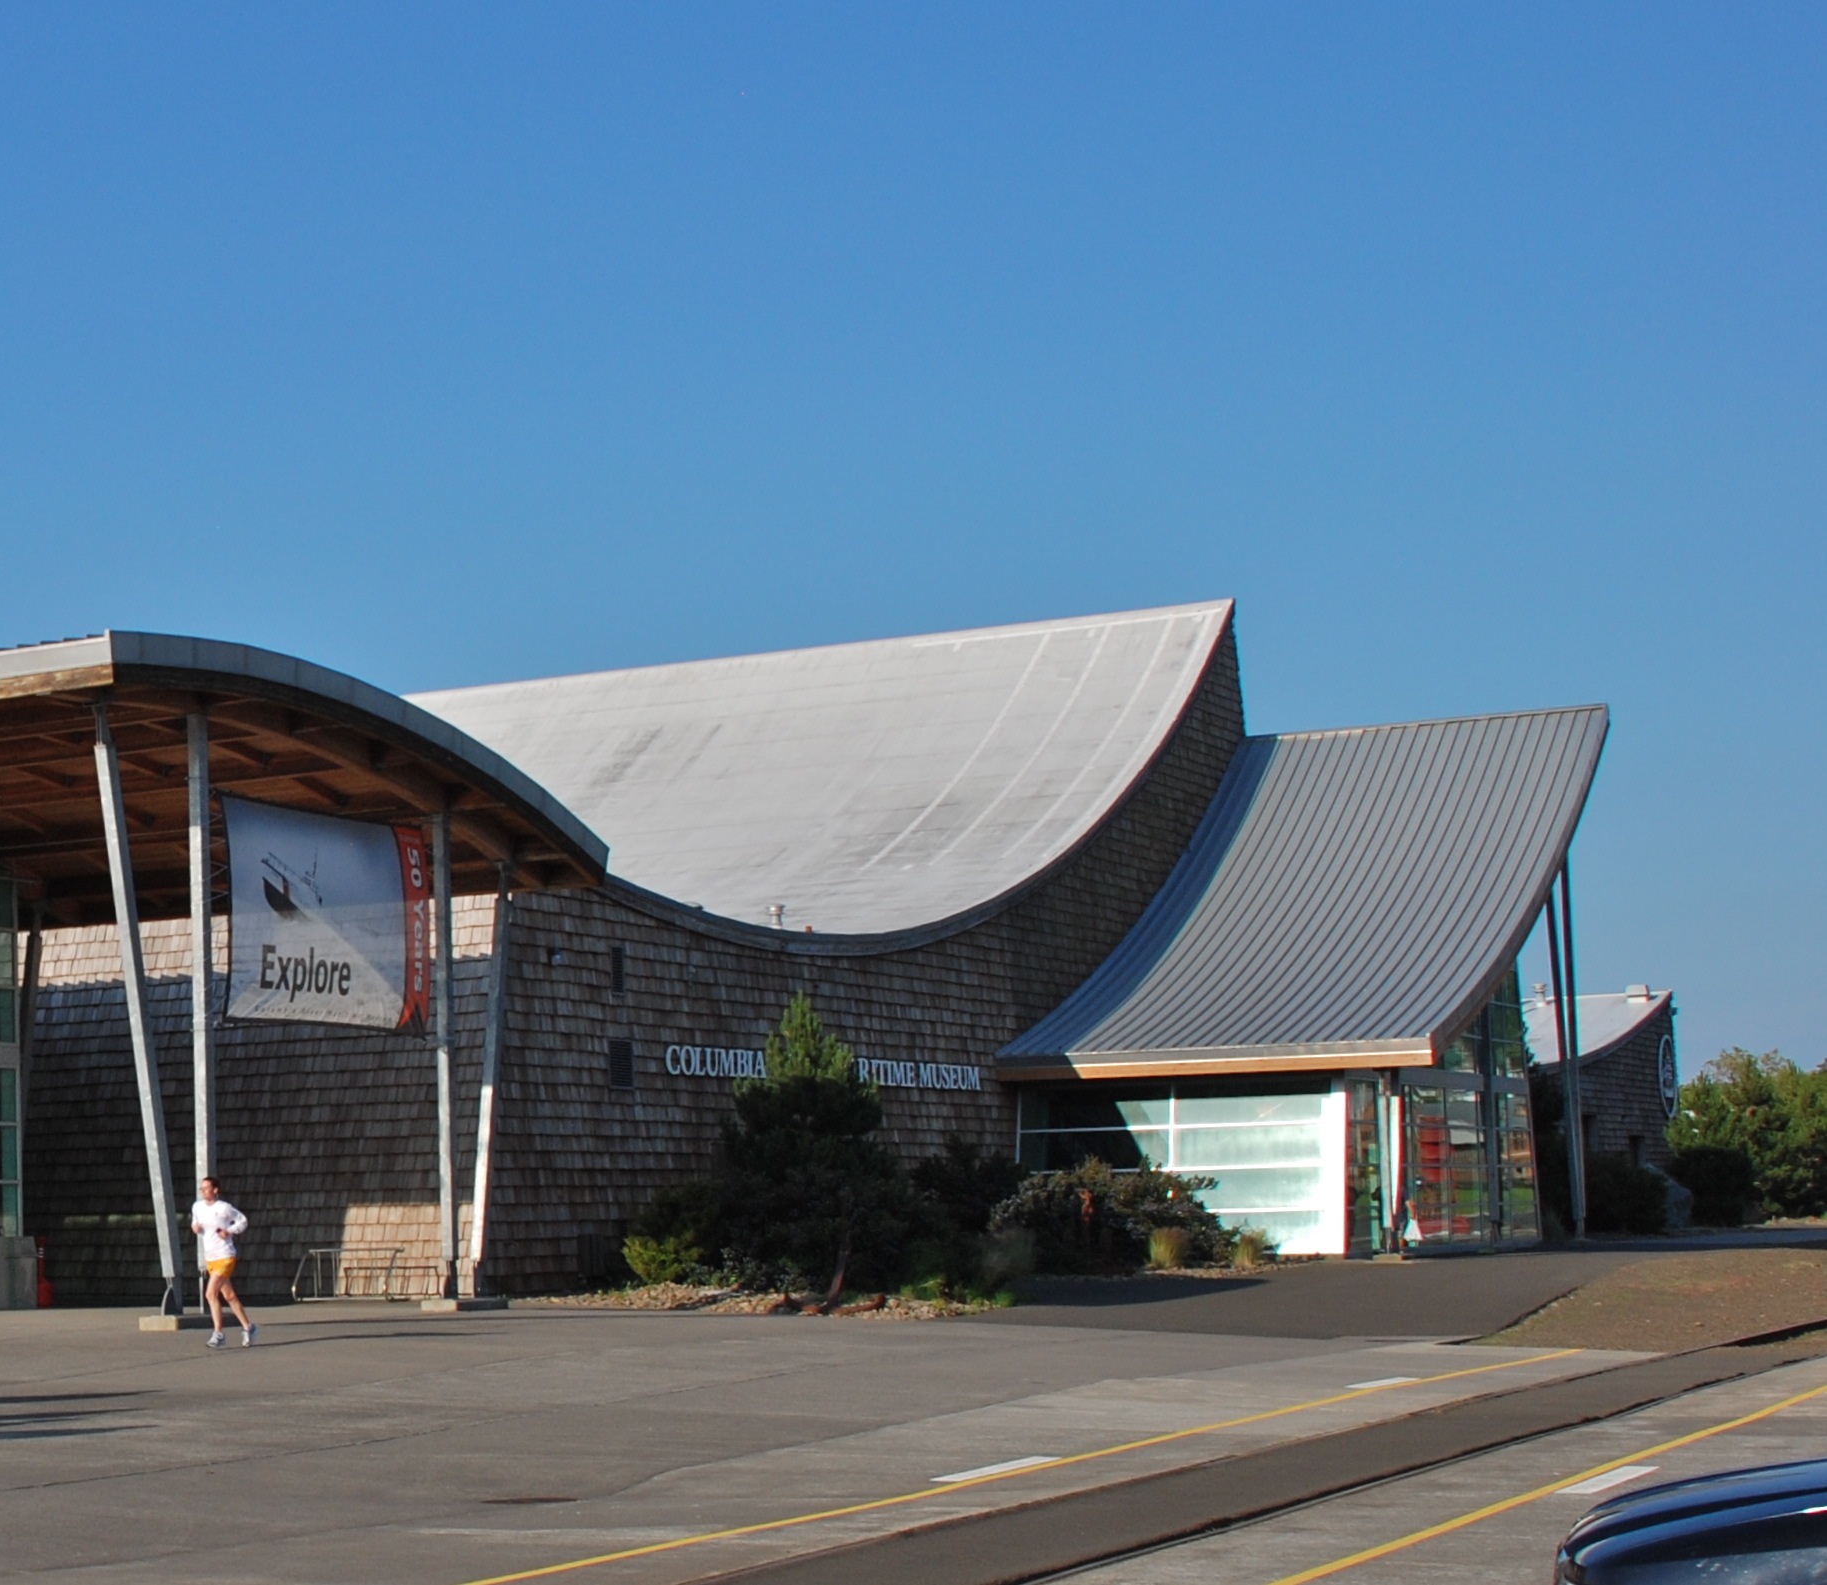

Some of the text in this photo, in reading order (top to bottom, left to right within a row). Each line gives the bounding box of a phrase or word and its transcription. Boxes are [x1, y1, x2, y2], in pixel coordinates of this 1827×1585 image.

[407, 846, 423, 889] 50
[259, 944, 352, 1003] Explore
[665, 1044, 767, 1079] COLUMBIA
[919, 1062, 982, 1091] MUSEUM
